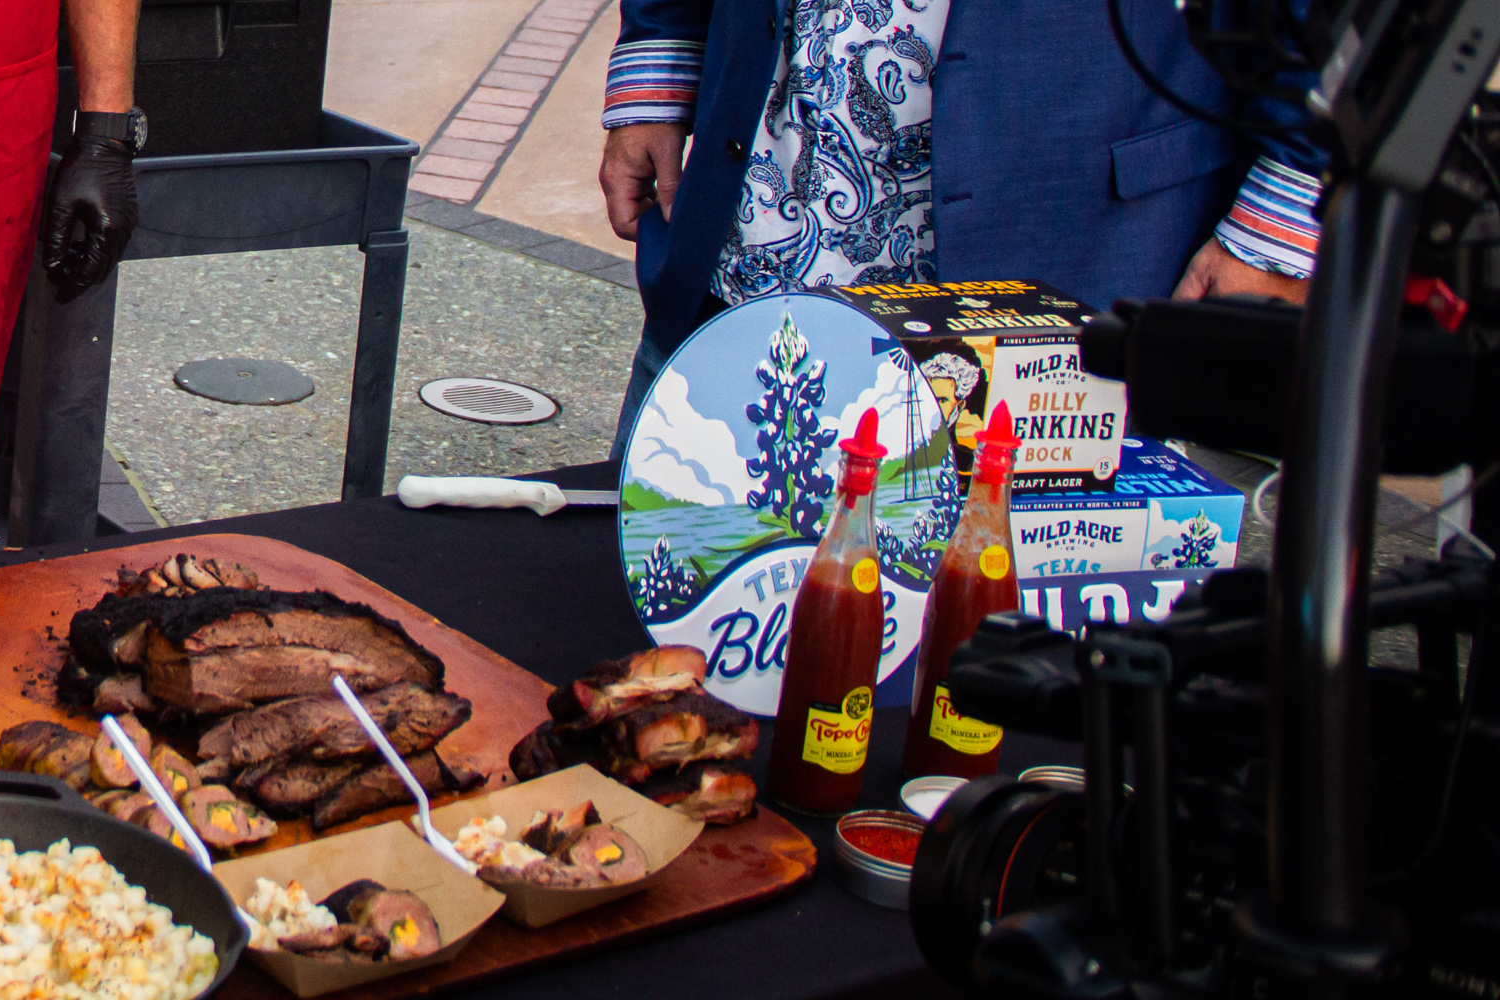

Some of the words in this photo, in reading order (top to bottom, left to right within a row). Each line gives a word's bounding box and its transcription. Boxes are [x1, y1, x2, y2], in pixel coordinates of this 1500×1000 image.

[840, 284, 940, 295] WILD
[940, 280, 1036, 292] ACRE
[959, 308, 1021, 317] BILLY
[946, 314, 1073, 331] JENKINS
[1015, 354, 1062, 380] WILD
[1038, 372, 1086, 383] BREWING
[1028, 392, 1088, 412] BILLY
[1014, 412, 1116, 440] ENKINS
[1025, 447, 1072, 462] BOCK
[1099, 461, 1109, 470] 15
[1012, 479, 1046, 489] CRAFT
[1049, 478, 1082, 487] LAGER
[1020, 520, 1071, 544] WILD
[1074, 519, 1123, 543] ACRE
[1046, 538, 1095, 549] BREWING
[1033, 558, 1101, 577] TEXAS
[810, 717, 853, 742] Topo
